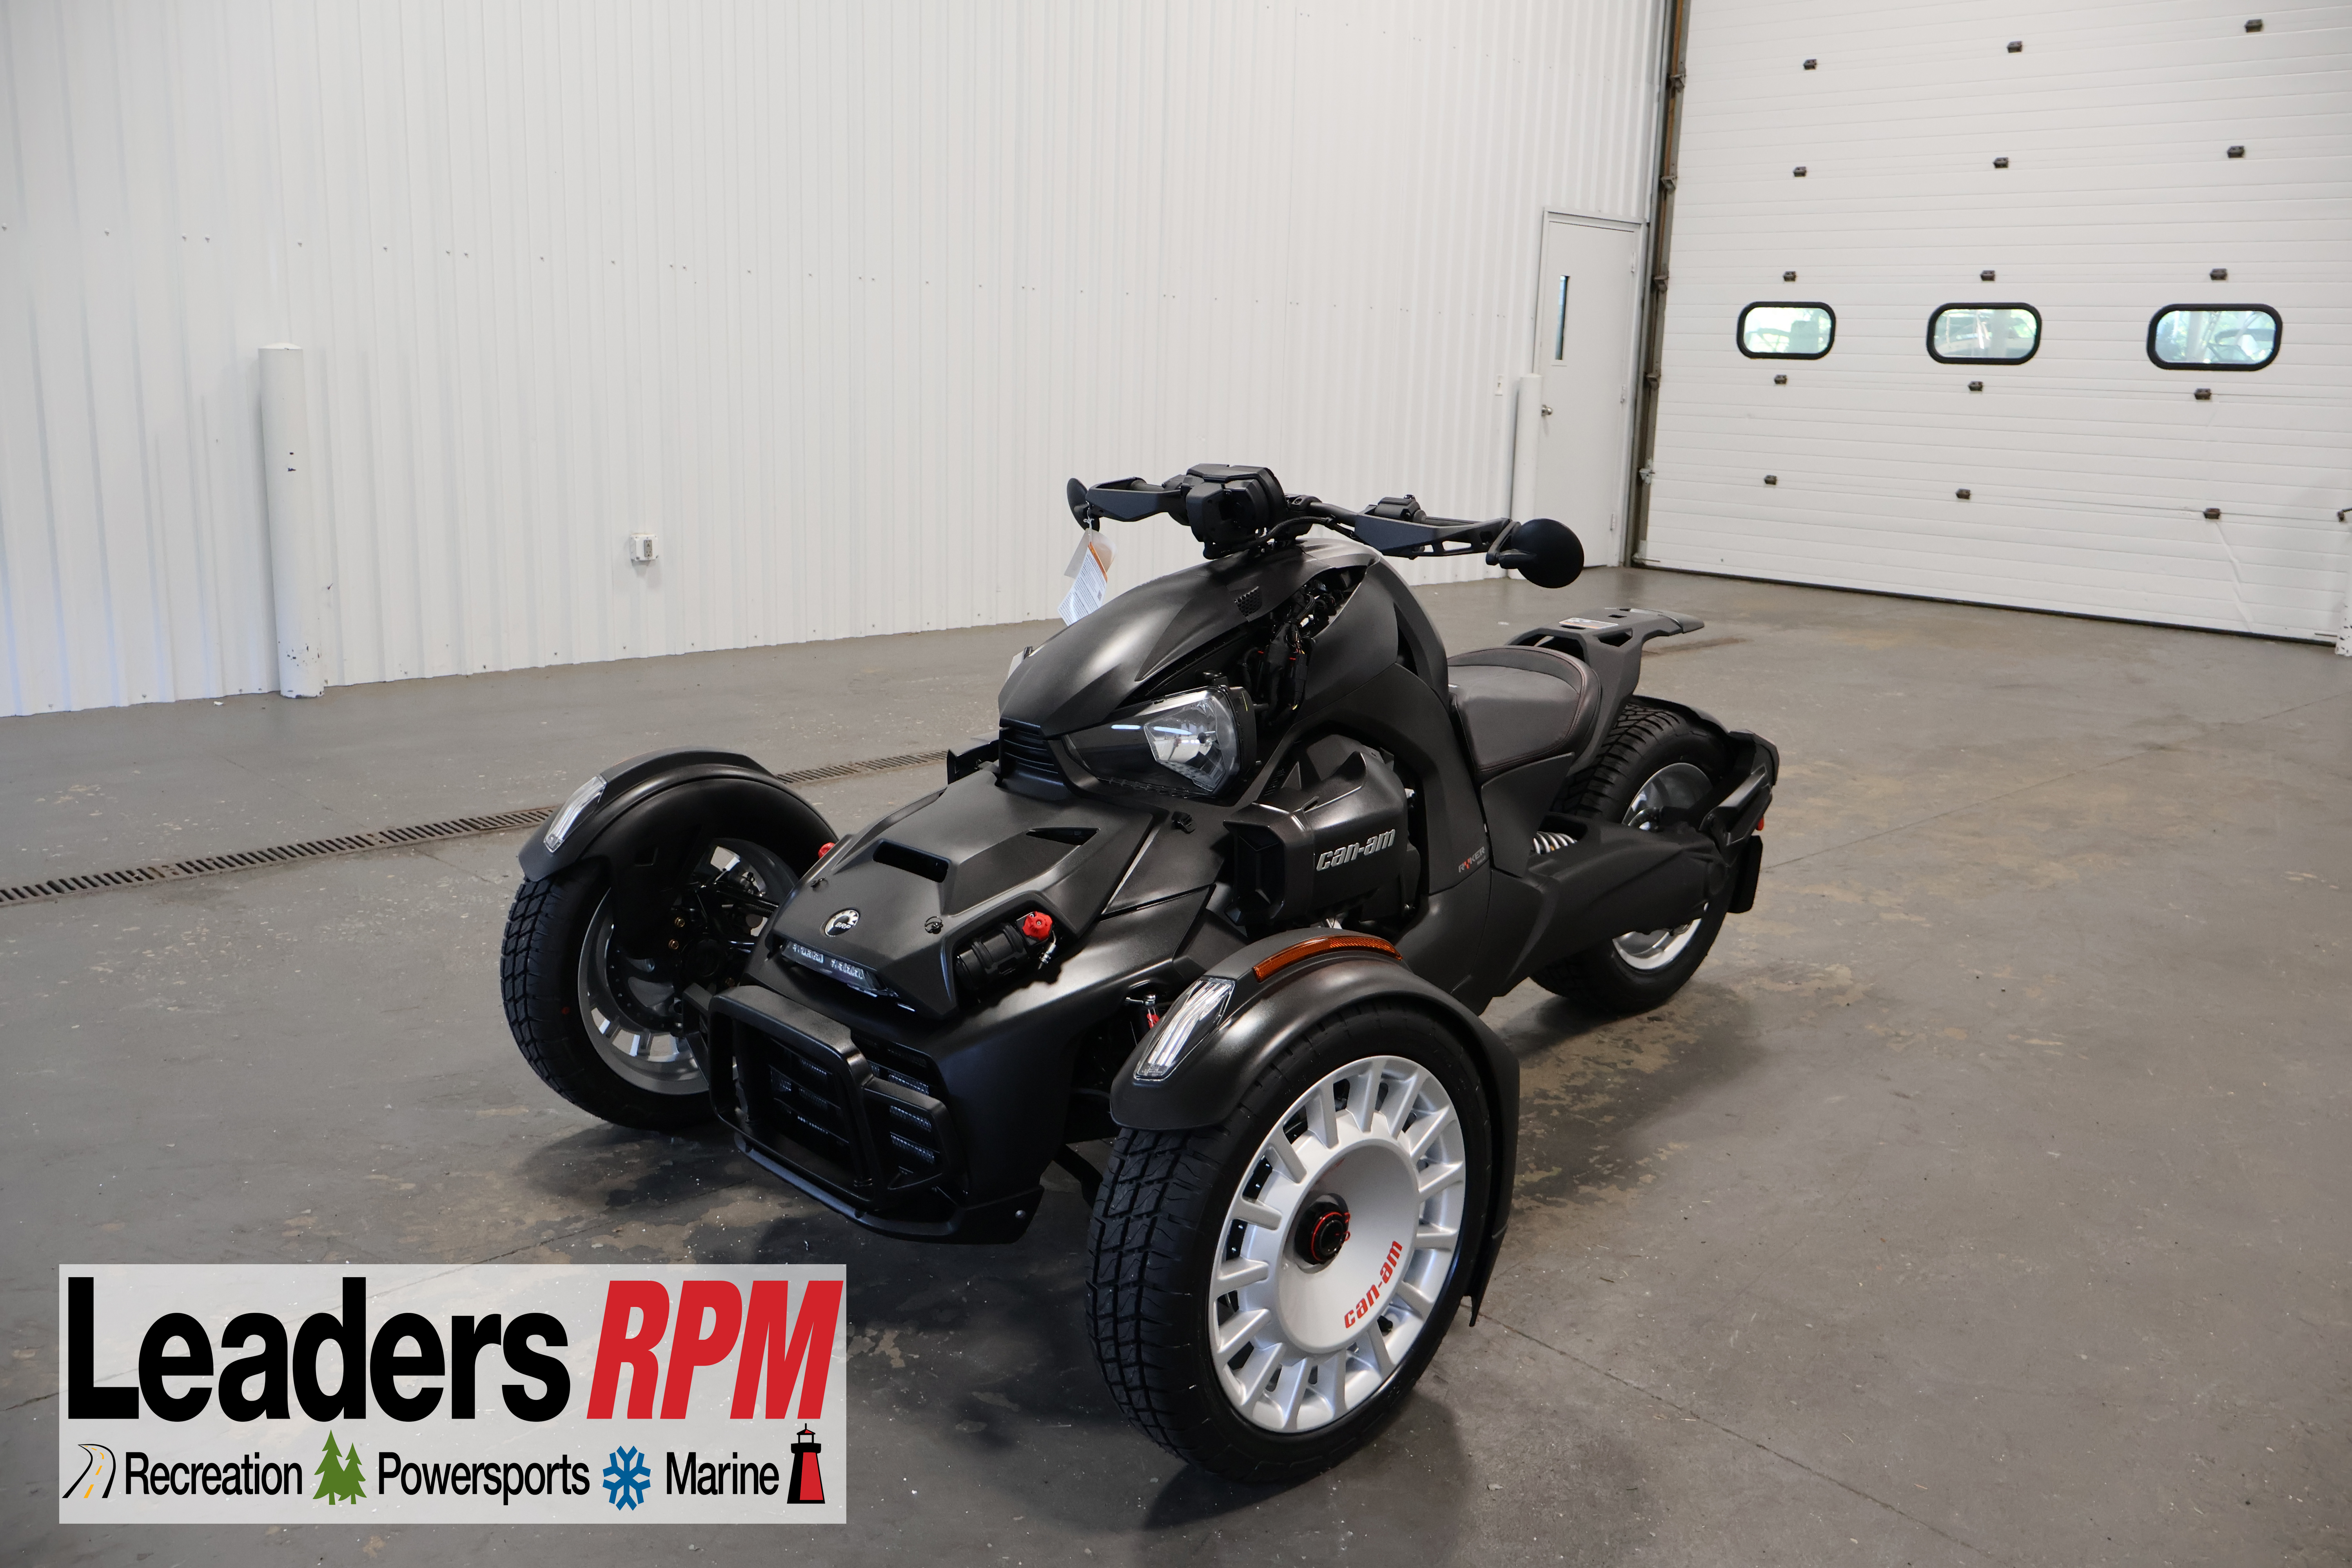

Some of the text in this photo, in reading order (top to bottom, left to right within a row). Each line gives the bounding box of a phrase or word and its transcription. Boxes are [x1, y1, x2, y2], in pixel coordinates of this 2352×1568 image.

[1316, 829, 1396, 871] can-am
[1458, 846, 1485, 873] RYKER
[1344, 1240, 1403, 1328] can-am
